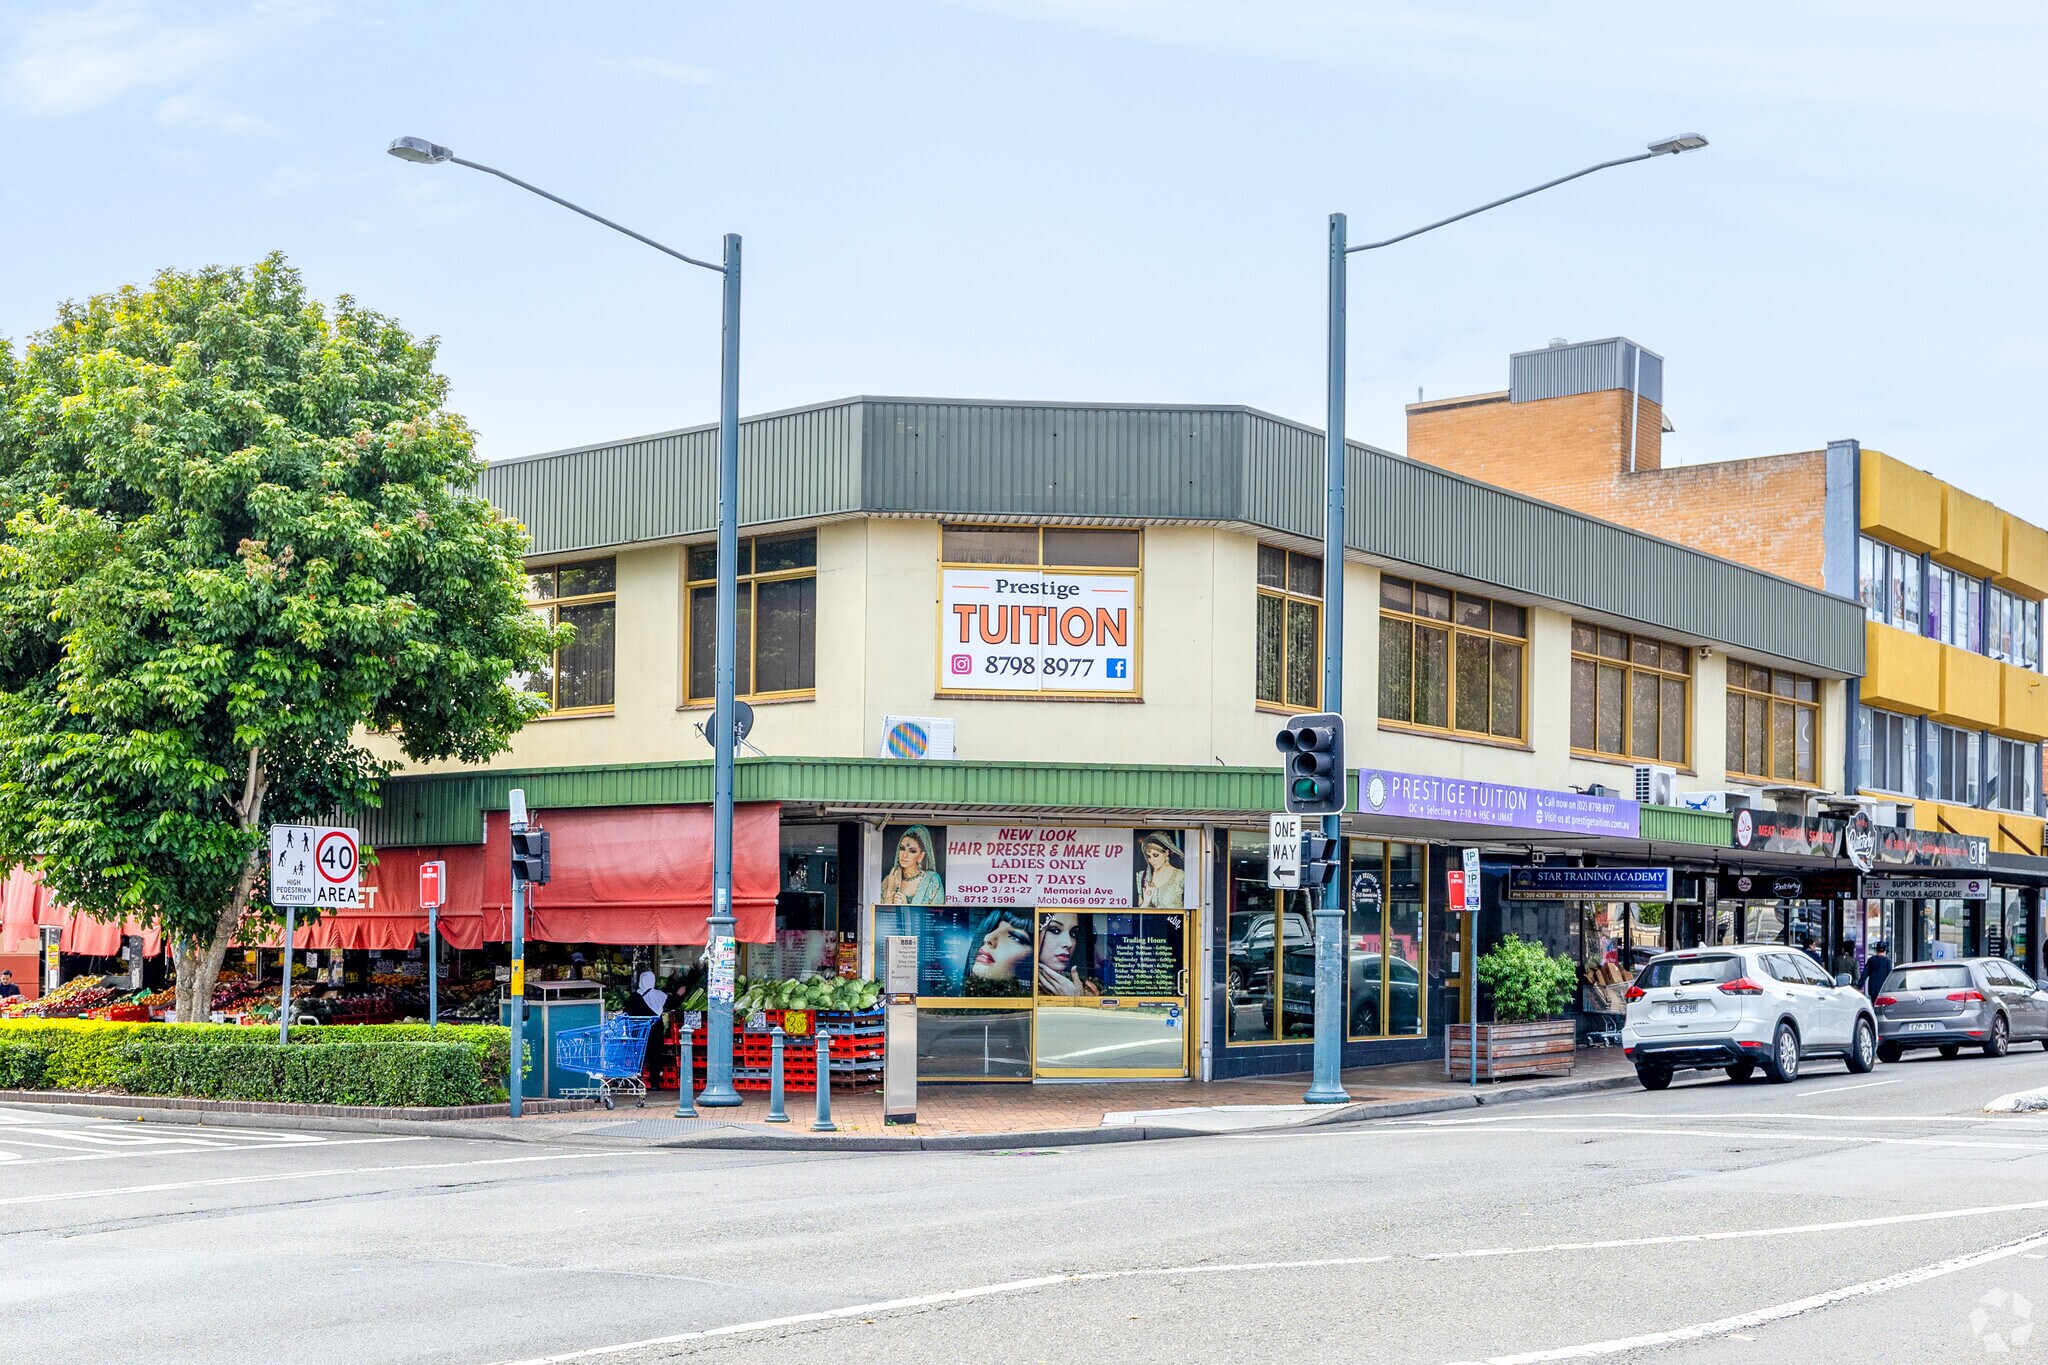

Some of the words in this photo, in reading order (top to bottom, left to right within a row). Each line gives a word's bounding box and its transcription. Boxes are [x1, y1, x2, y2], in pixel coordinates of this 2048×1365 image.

[996, 579, 1080, 599] Prestige
[953, 604, 1127, 647] TUITION
[985, 656, 1035, 676] 8798
[1043, 657, 1095, 677] 8977
[1392, 777, 1465, 804] PRESTIGE
[1471, 785, 1527, 811] TUITION
[1409, 803, 1418, 813] OC
[1426, 805, 1451, 817] Selective
[1459, 808, 1472, 818] 7-10
[1480, 811, 1490, 820] HSC
[1544, 796, 1555, 807] Call
[1556, 800, 1567, 809] now
[1568, 801, 1576, 810] on
[1577, 800, 1588, 812] (02)
[1588, 802, 1601, 812] 8798
[1602, 804, 1615, 814] 8977
[1544, 811, 1557, 821] Visit
[1557, 814, 1564, 823] us
[1565, 815, 1571, 824] at
[1571, 815, 1630, 830] prestigetuition.com.au
[998, 828, 1033, 841] NEW
[1039, 829, 1077, 842] LOOK
[1275, 822, 1296, 838] ONE
[1758, 825, 1775, 837] MEAT
[321, 845, 351, 869] 40
[948, 841, 982, 856] HAIR
[986, 842, 1045, 857] DRESSER
[1050, 844, 1058, 857] &
[1063, 844, 1100, 857] MAKE
[1105, 844, 1123, 858] UP
[1273, 844, 1297, 860] WAY
[1466, 851, 1476, 861] 1P
[991, 858, 1045, 869] LADIES
[1049, 859, 1087, 870] ONLY
[987, 874, 1028, 884] OPEN
[1036, 875, 1043, 884] 7
[1047, 875, 1086, 885] DAYS
[1468, 874, 1477, 883] 1P
[1538, 872, 1562, 881] STAR
[1564, 872, 1611, 881] TRAINING
[1613, 872, 1664, 881] ACADEMY
[1891, 880, 1922, 888] SUPPORT
[276, 886, 311, 894] PEDESTRIAN
[318, 887, 357, 902] AREA
[958, 885, 989, 893] SHOP
[1043, 887, 1091, 895] Memorial
[1094, 887, 1114, 895] Ave
[945, 895, 961, 903] Ph.
[1088, 897, 1106, 905] 097
[1109, 897, 1127, 905] 210
